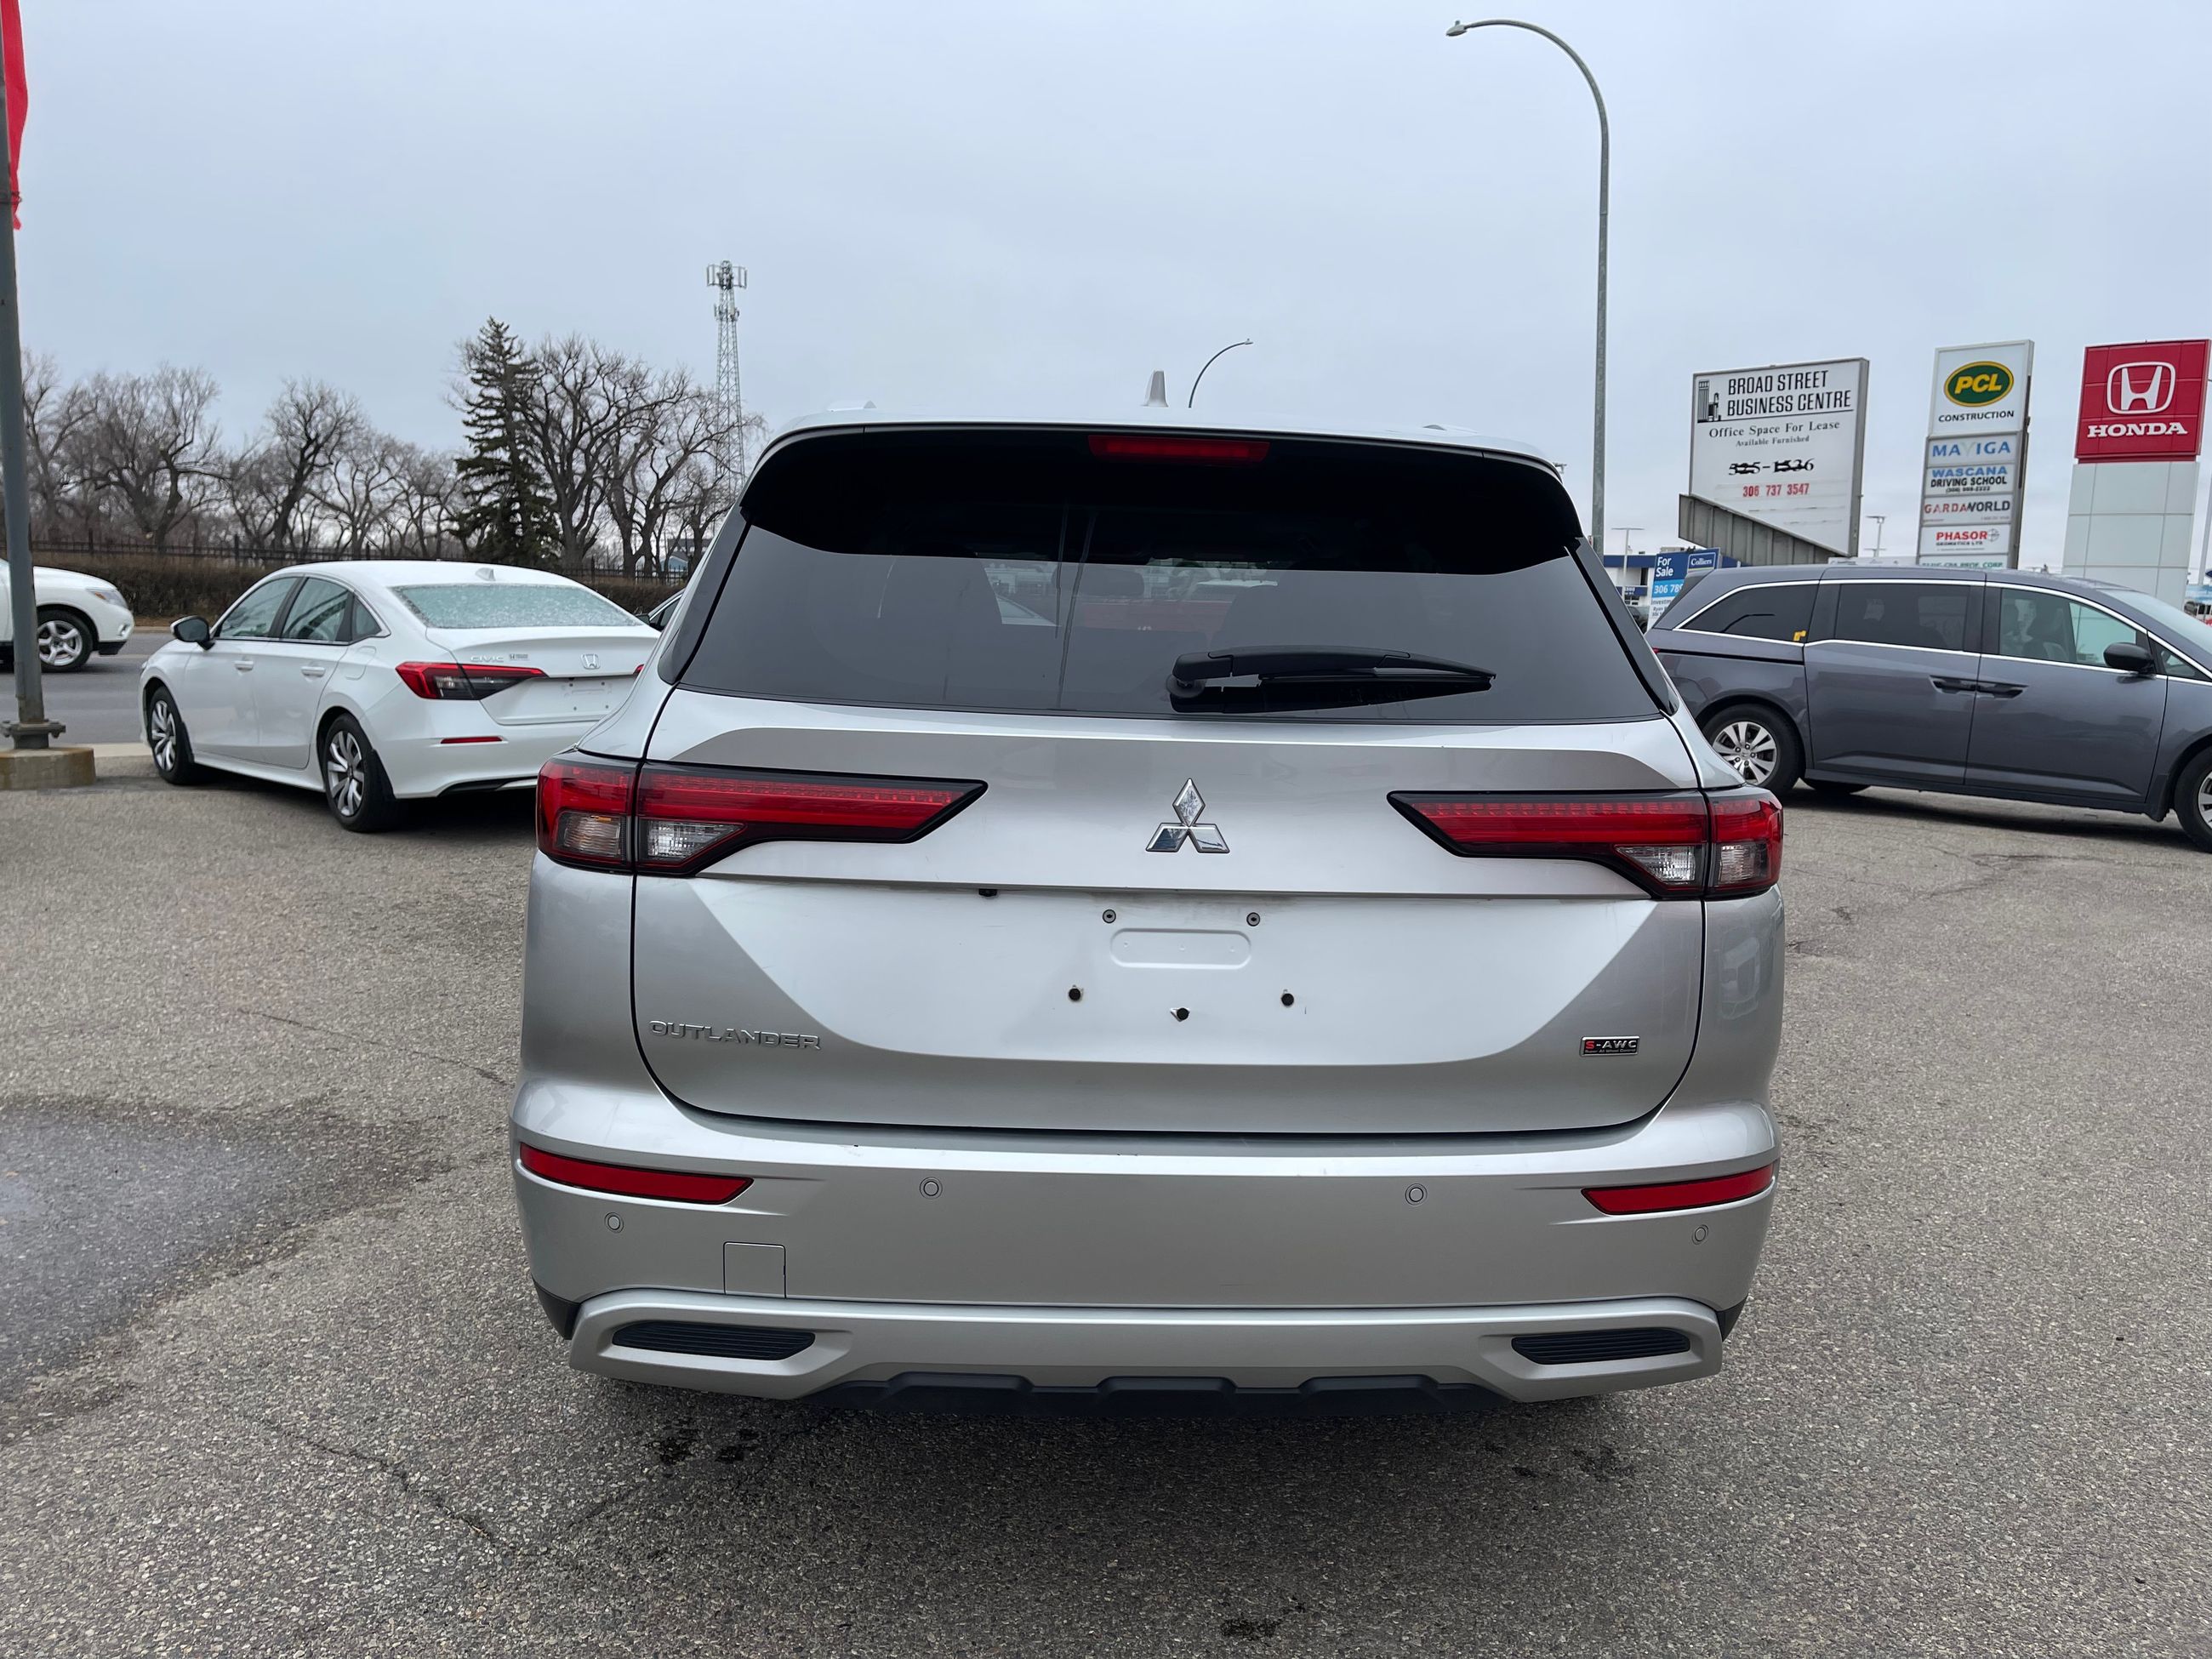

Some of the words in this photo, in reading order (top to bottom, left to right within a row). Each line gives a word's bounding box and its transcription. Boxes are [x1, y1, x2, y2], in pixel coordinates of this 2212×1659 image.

[1728, 375, 1773, 396] BROAD
[1777, 370, 1829, 391] STREET
[1954, 373, 2004, 394] PCL
[1727, 394, 1793, 416] BUSINESS
[1798, 390, 1851, 411] CENTRE
[1938, 410, 2015, 423] CONSTRUCTION
[1708, 427, 1745, 438] Office
[1748, 425, 1781, 436] Space
[1785, 423, 1804, 433] For
[1809, 420, 1840, 431] Lease
[2087, 421, 2188, 438] HONDA
[1736, 438, 1769, 448] Available
[1772, 435, 1810, 444] Furnished
[1931, 466, 2008, 478] WASCANA
[1930, 477, 1968, 487] DRIVING
[1970, 476, 2007, 486] SCHOOL
[1742, 485, 1760, 498] 306
[1765, 484, 1782, 496] 737
[1787, 482, 1810, 495] 3547
[1936, 530, 1988, 541] PHASOR
[1656, 556, 1672, 567] For
[1690, 557, 1713, 566] Colliers
[1656, 567, 1674, 578] Sale
[1654, 584, 1668, 595] 306
[649, 1020, 822, 1051] OUTLANDER
[1585, 1040, 1637, 1049] S-AWC
